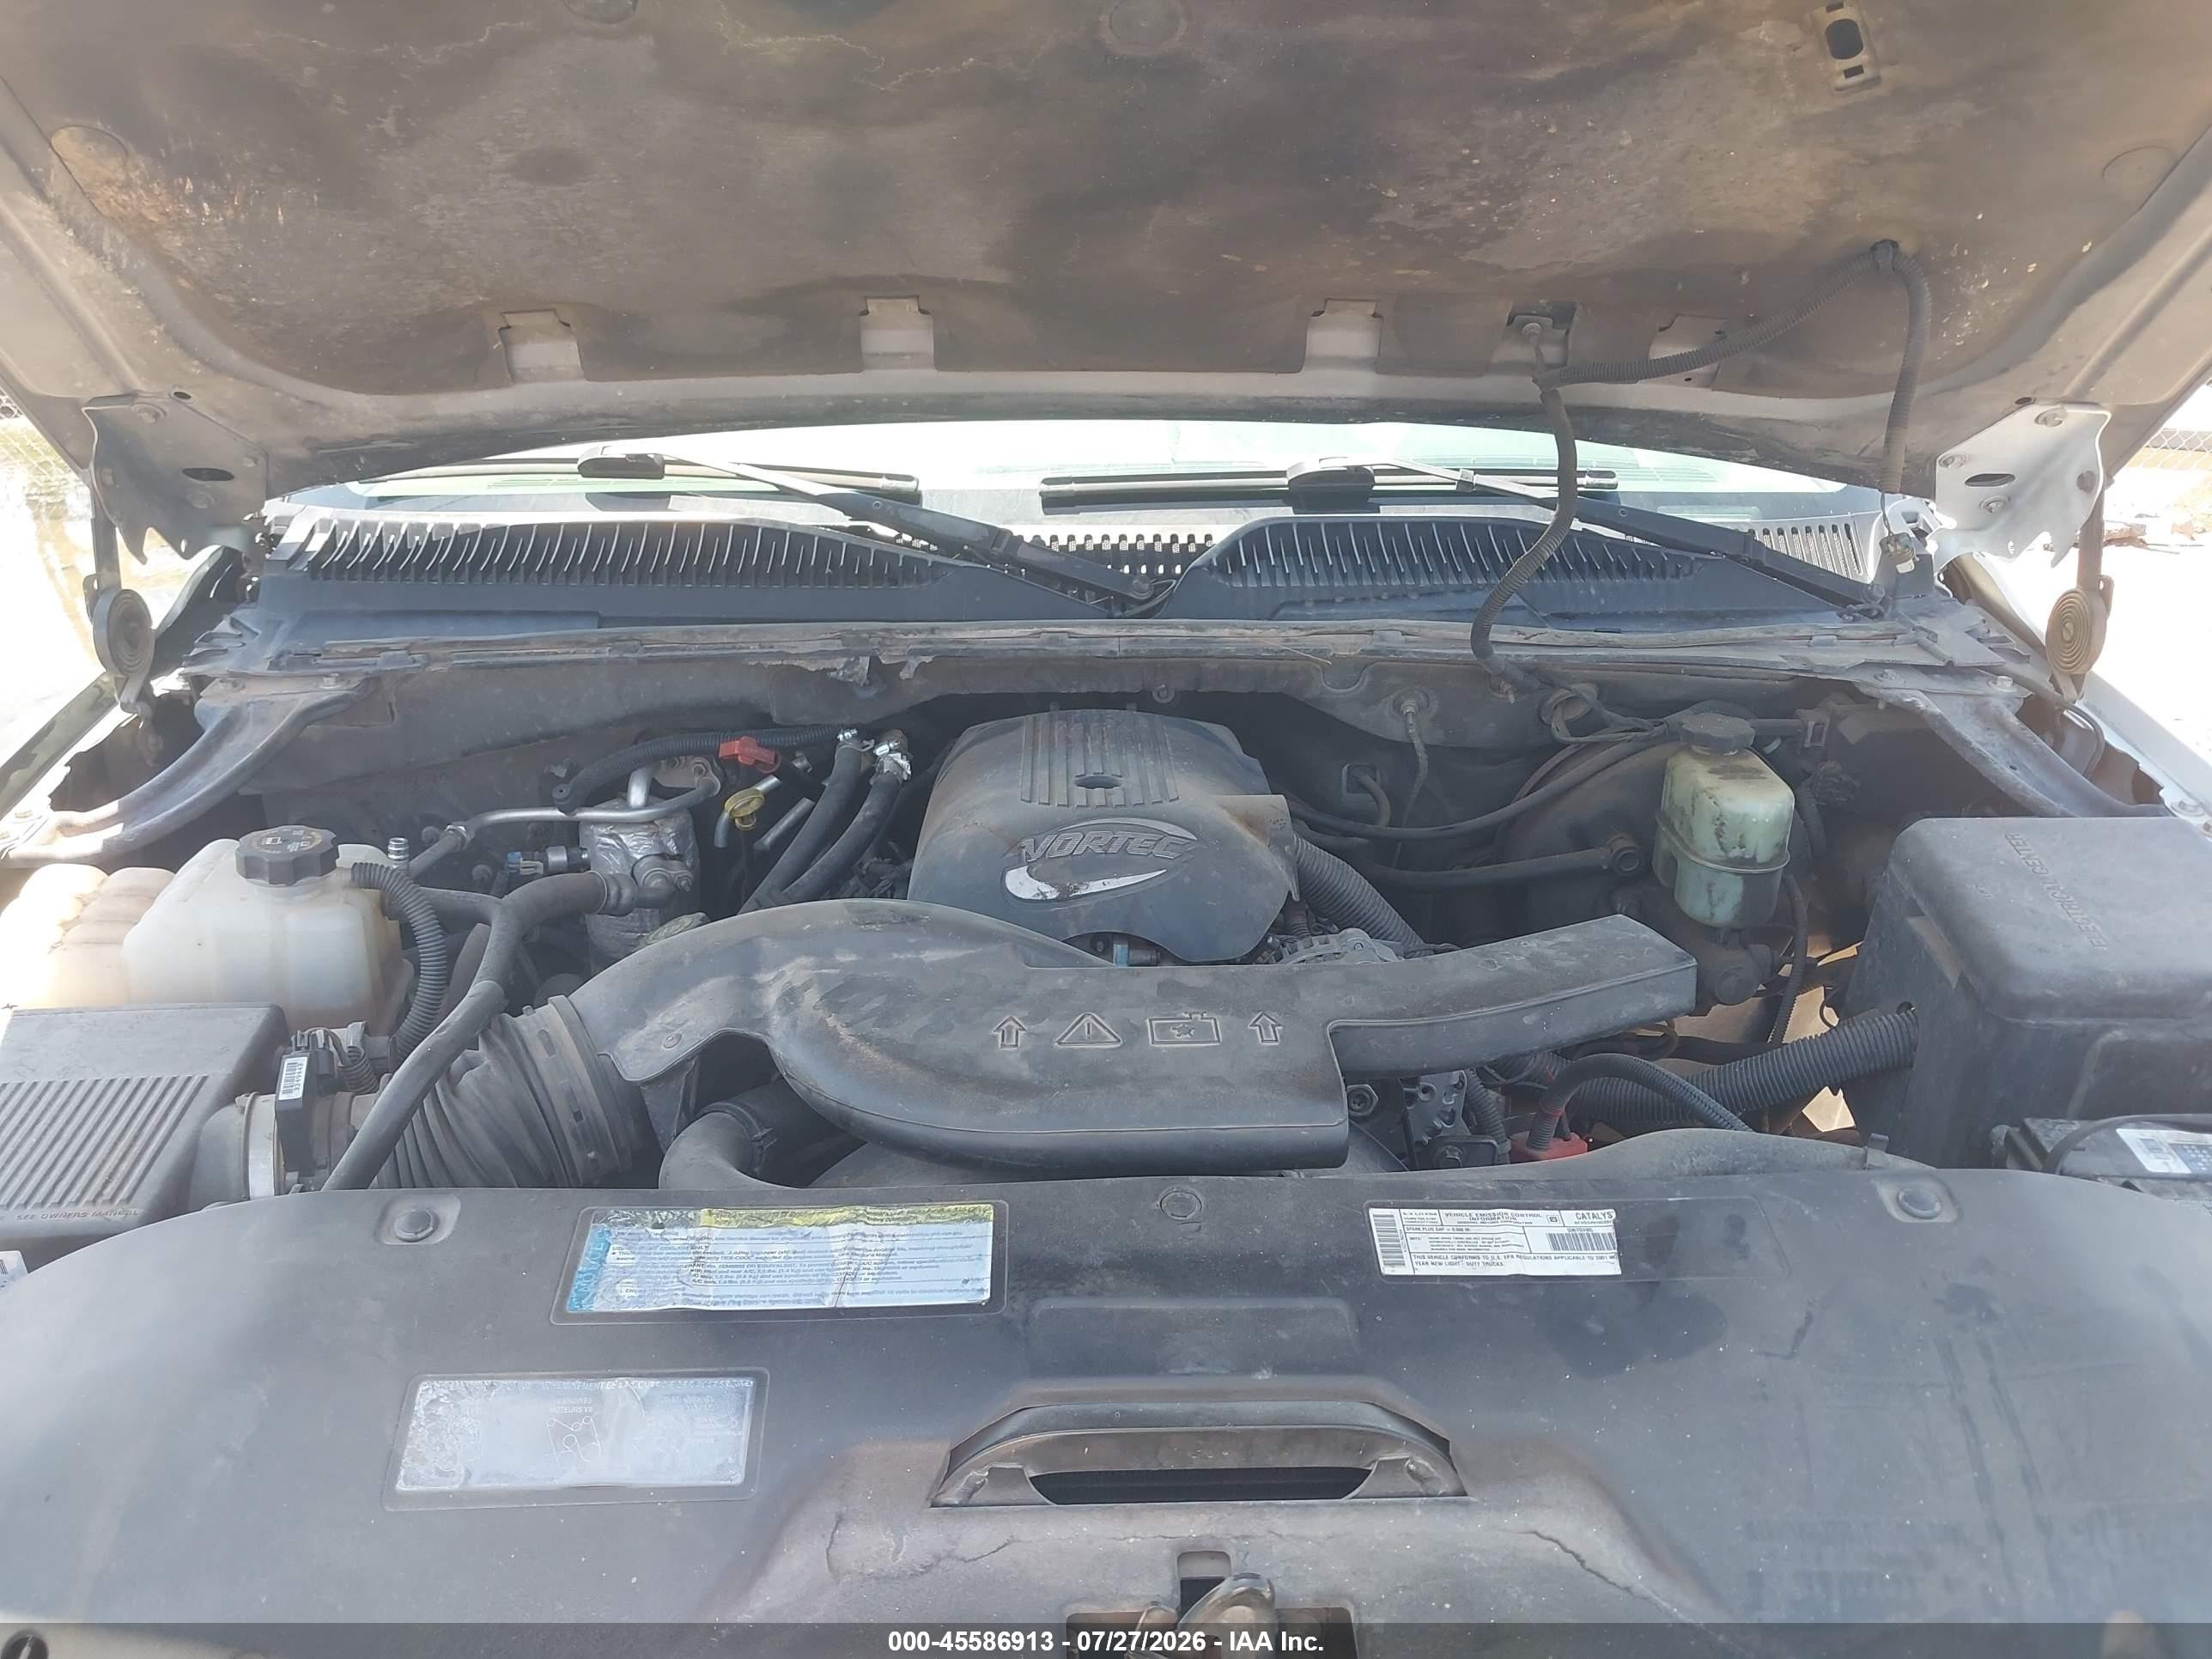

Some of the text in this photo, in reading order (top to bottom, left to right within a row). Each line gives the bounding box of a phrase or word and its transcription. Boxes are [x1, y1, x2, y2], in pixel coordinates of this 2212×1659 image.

[1021, 831, 1190, 862] VORTEC
[2004, 832, 2109, 950] ELECTRICAL CENTER
[41, 1210, 89, 1219] OWNERS
[92, 1207, 138, 1218] MANUAL
[1576, 1211, 1613, 1220] CATALYS
